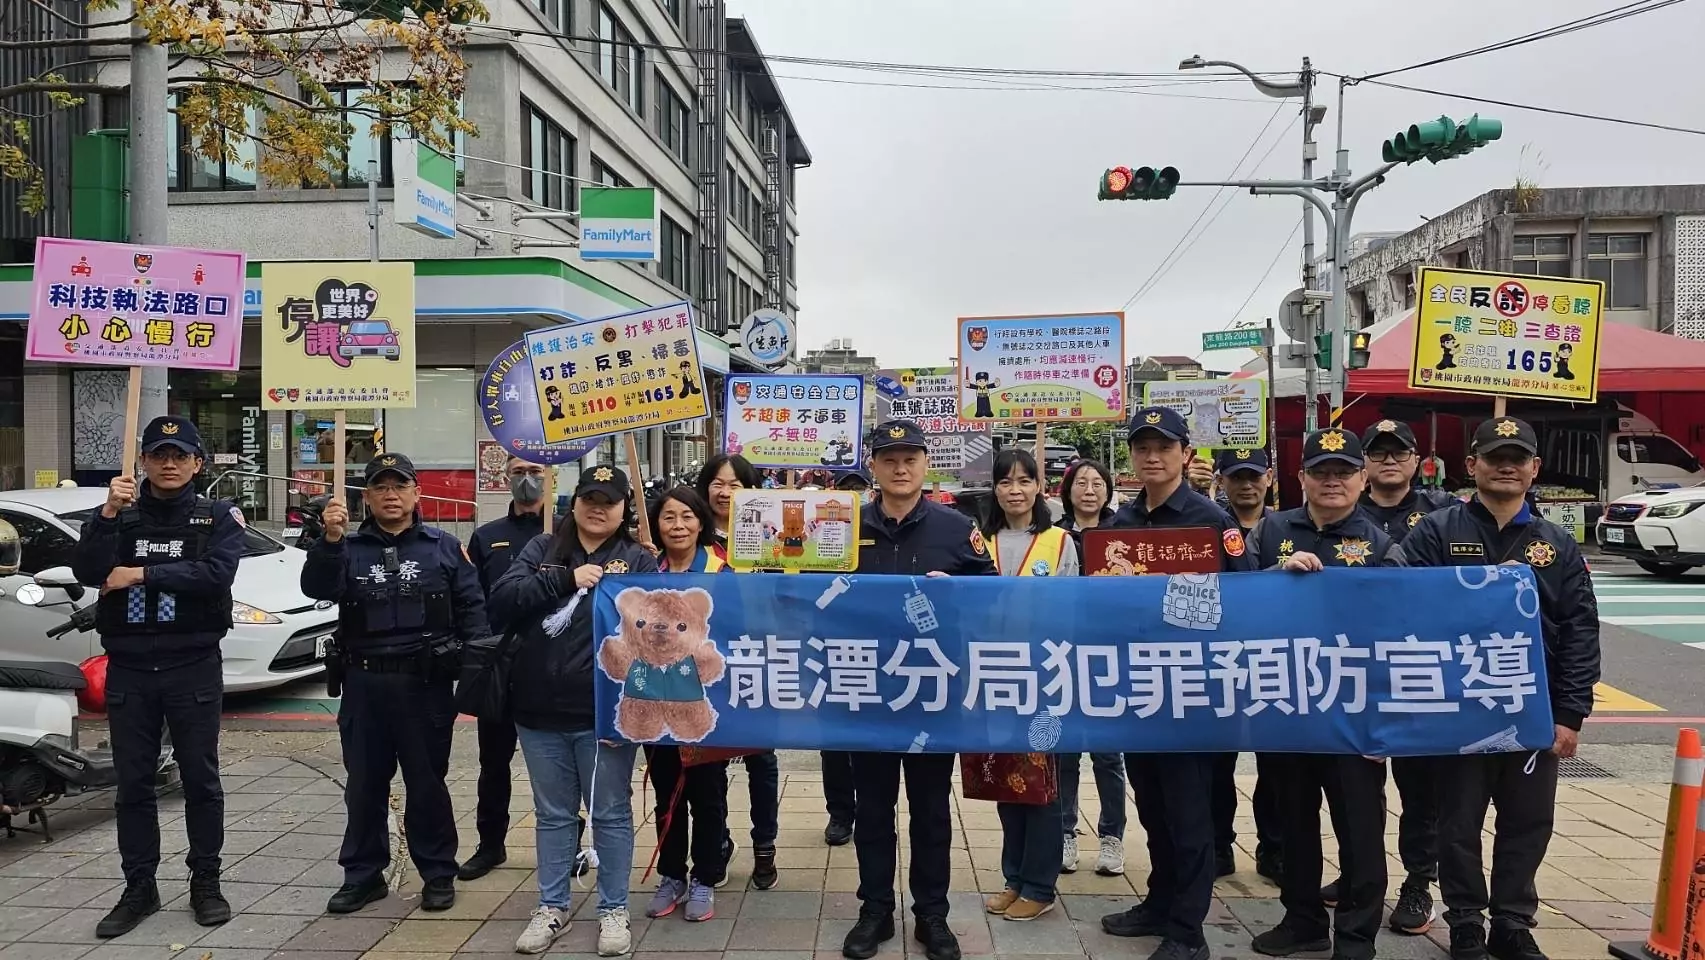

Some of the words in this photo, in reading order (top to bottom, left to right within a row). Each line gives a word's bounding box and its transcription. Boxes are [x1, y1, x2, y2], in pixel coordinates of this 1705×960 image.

[417, 190, 453, 218] FamilyMart
[583, 228, 652, 244] FamilyMart
[49, 283, 228, 316] 科技執法路口
[330, 288, 361, 303] 世界
[278, 297, 314, 343] 停
[321, 304, 369, 319] 更美好
[59, 314, 215, 347] 小心慢行
[624, 312, 689, 339] 打擊犯罪
[1435, 315, 1473, 333] 一聽
[1478, 317, 1518, 338] 二掛
[1524, 321, 1582, 343] 三查證
[531, 332, 596, 357] 維護治安
[755, 334, 789, 351] 生魚片
[1506, 348, 1552, 374] 165
[1097, 367, 1114, 385] 停
[645, 385, 675, 403] 165
[755, 384, 858, 400] 交通安全宣導
[587, 395, 617, 414] 110
[891, 398, 958, 416] 無號誌路
[742, 407, 792, 424] 不超速
[797, 408, 847, 424] 不逼車
[769, 427, 818, 443] 不無照
[135, 539, 149, 557] 警
[149, 543, 169, 553] POLICE
[169, 540, 183, 557] 察
[1136, 542, 1214, 563] 龍福齊天
[1170, 583, 1216, 600] POLICE
[725, 631, 1538, 719] 龍潭分局犯罪預防宣導
